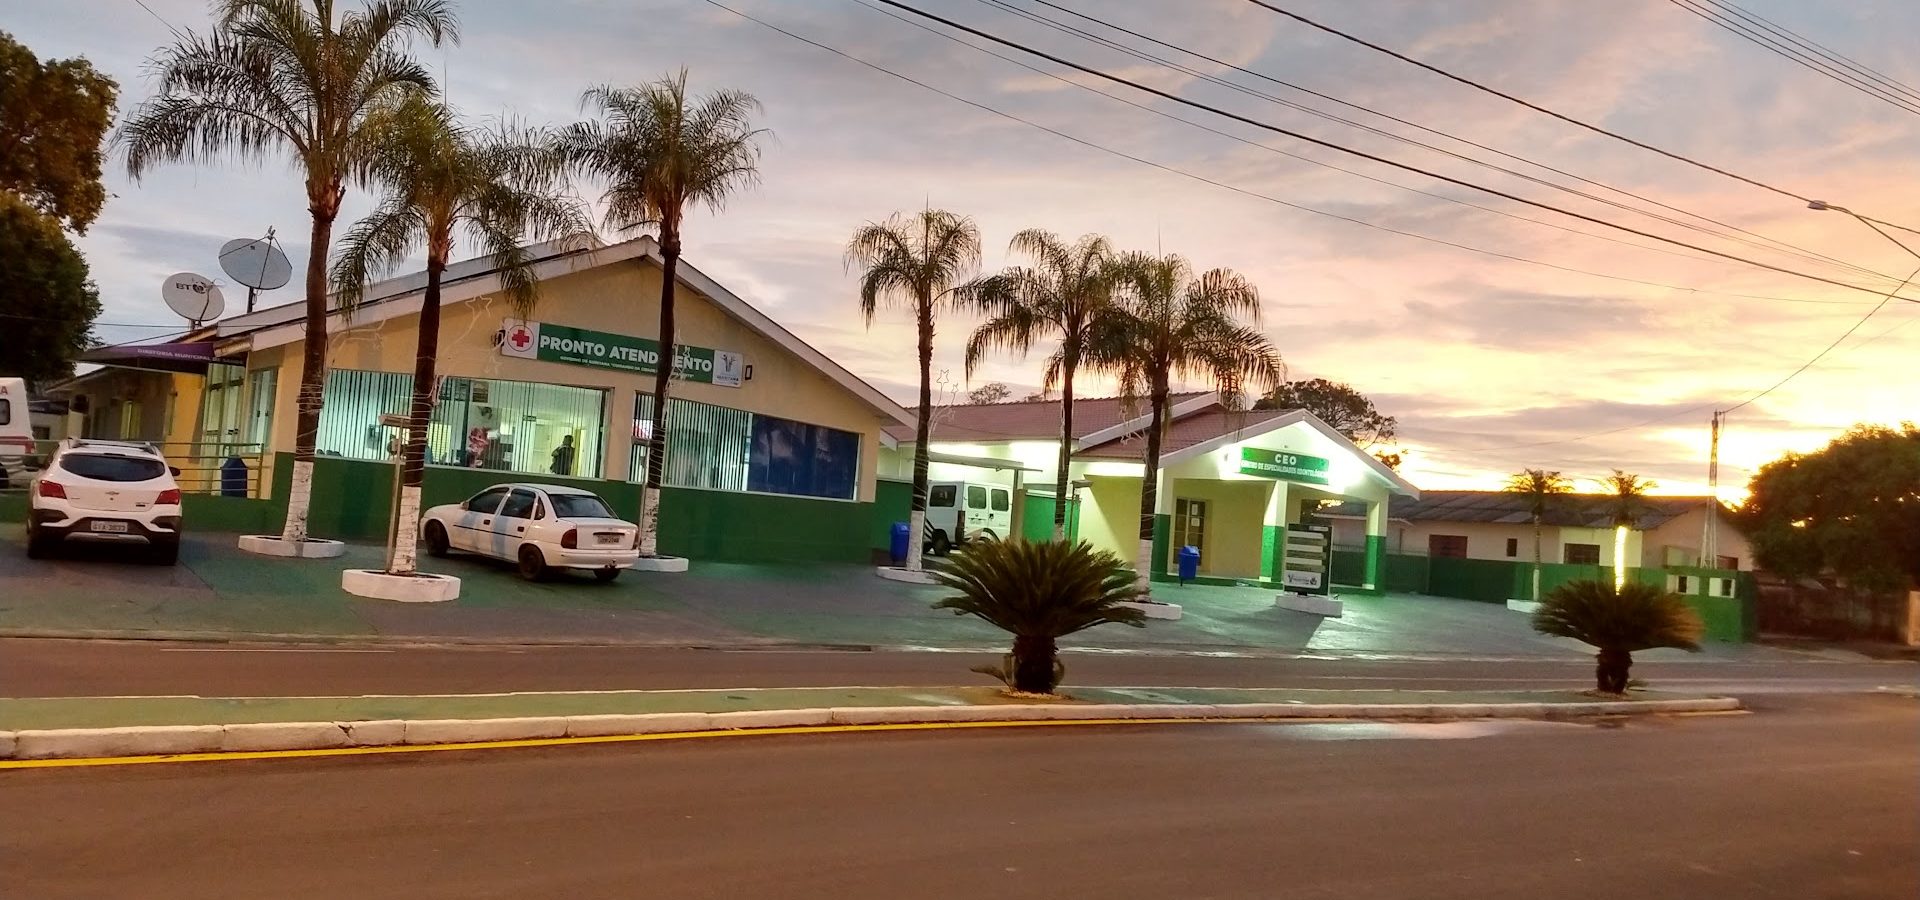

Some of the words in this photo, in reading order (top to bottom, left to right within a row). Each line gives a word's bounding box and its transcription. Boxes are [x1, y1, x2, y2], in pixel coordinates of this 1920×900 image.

[176, 282, 191, 290] BT
[540, 335, 606, 357] PRONTO
[609, 345, 713, 373] ATENDENTO
[1274, 453, 1297, 465] CEO
